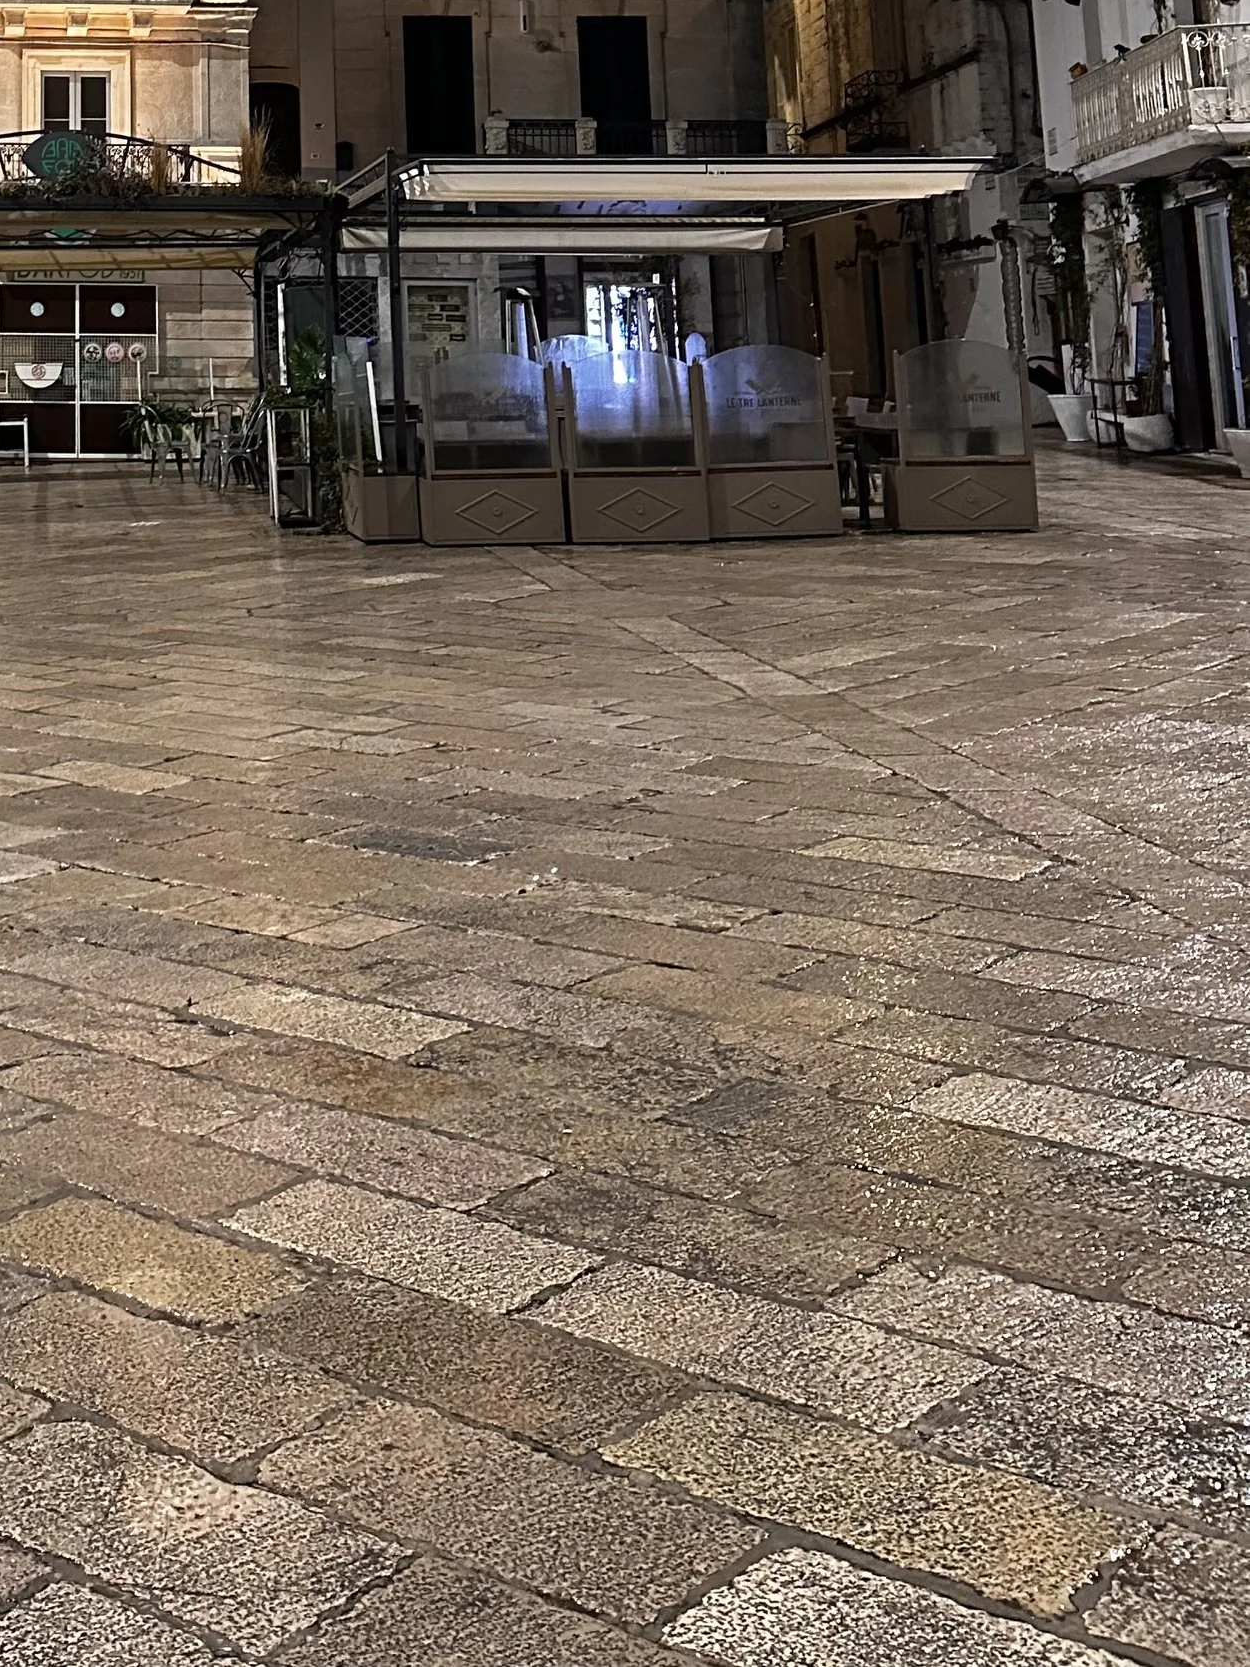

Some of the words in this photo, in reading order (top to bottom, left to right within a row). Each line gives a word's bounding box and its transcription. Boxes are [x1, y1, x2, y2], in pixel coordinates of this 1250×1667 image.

[41, 137, 84, 159] BAR
[726, 397, 736, 409] LE
[756, 395, 803, 408] LANTERNE
